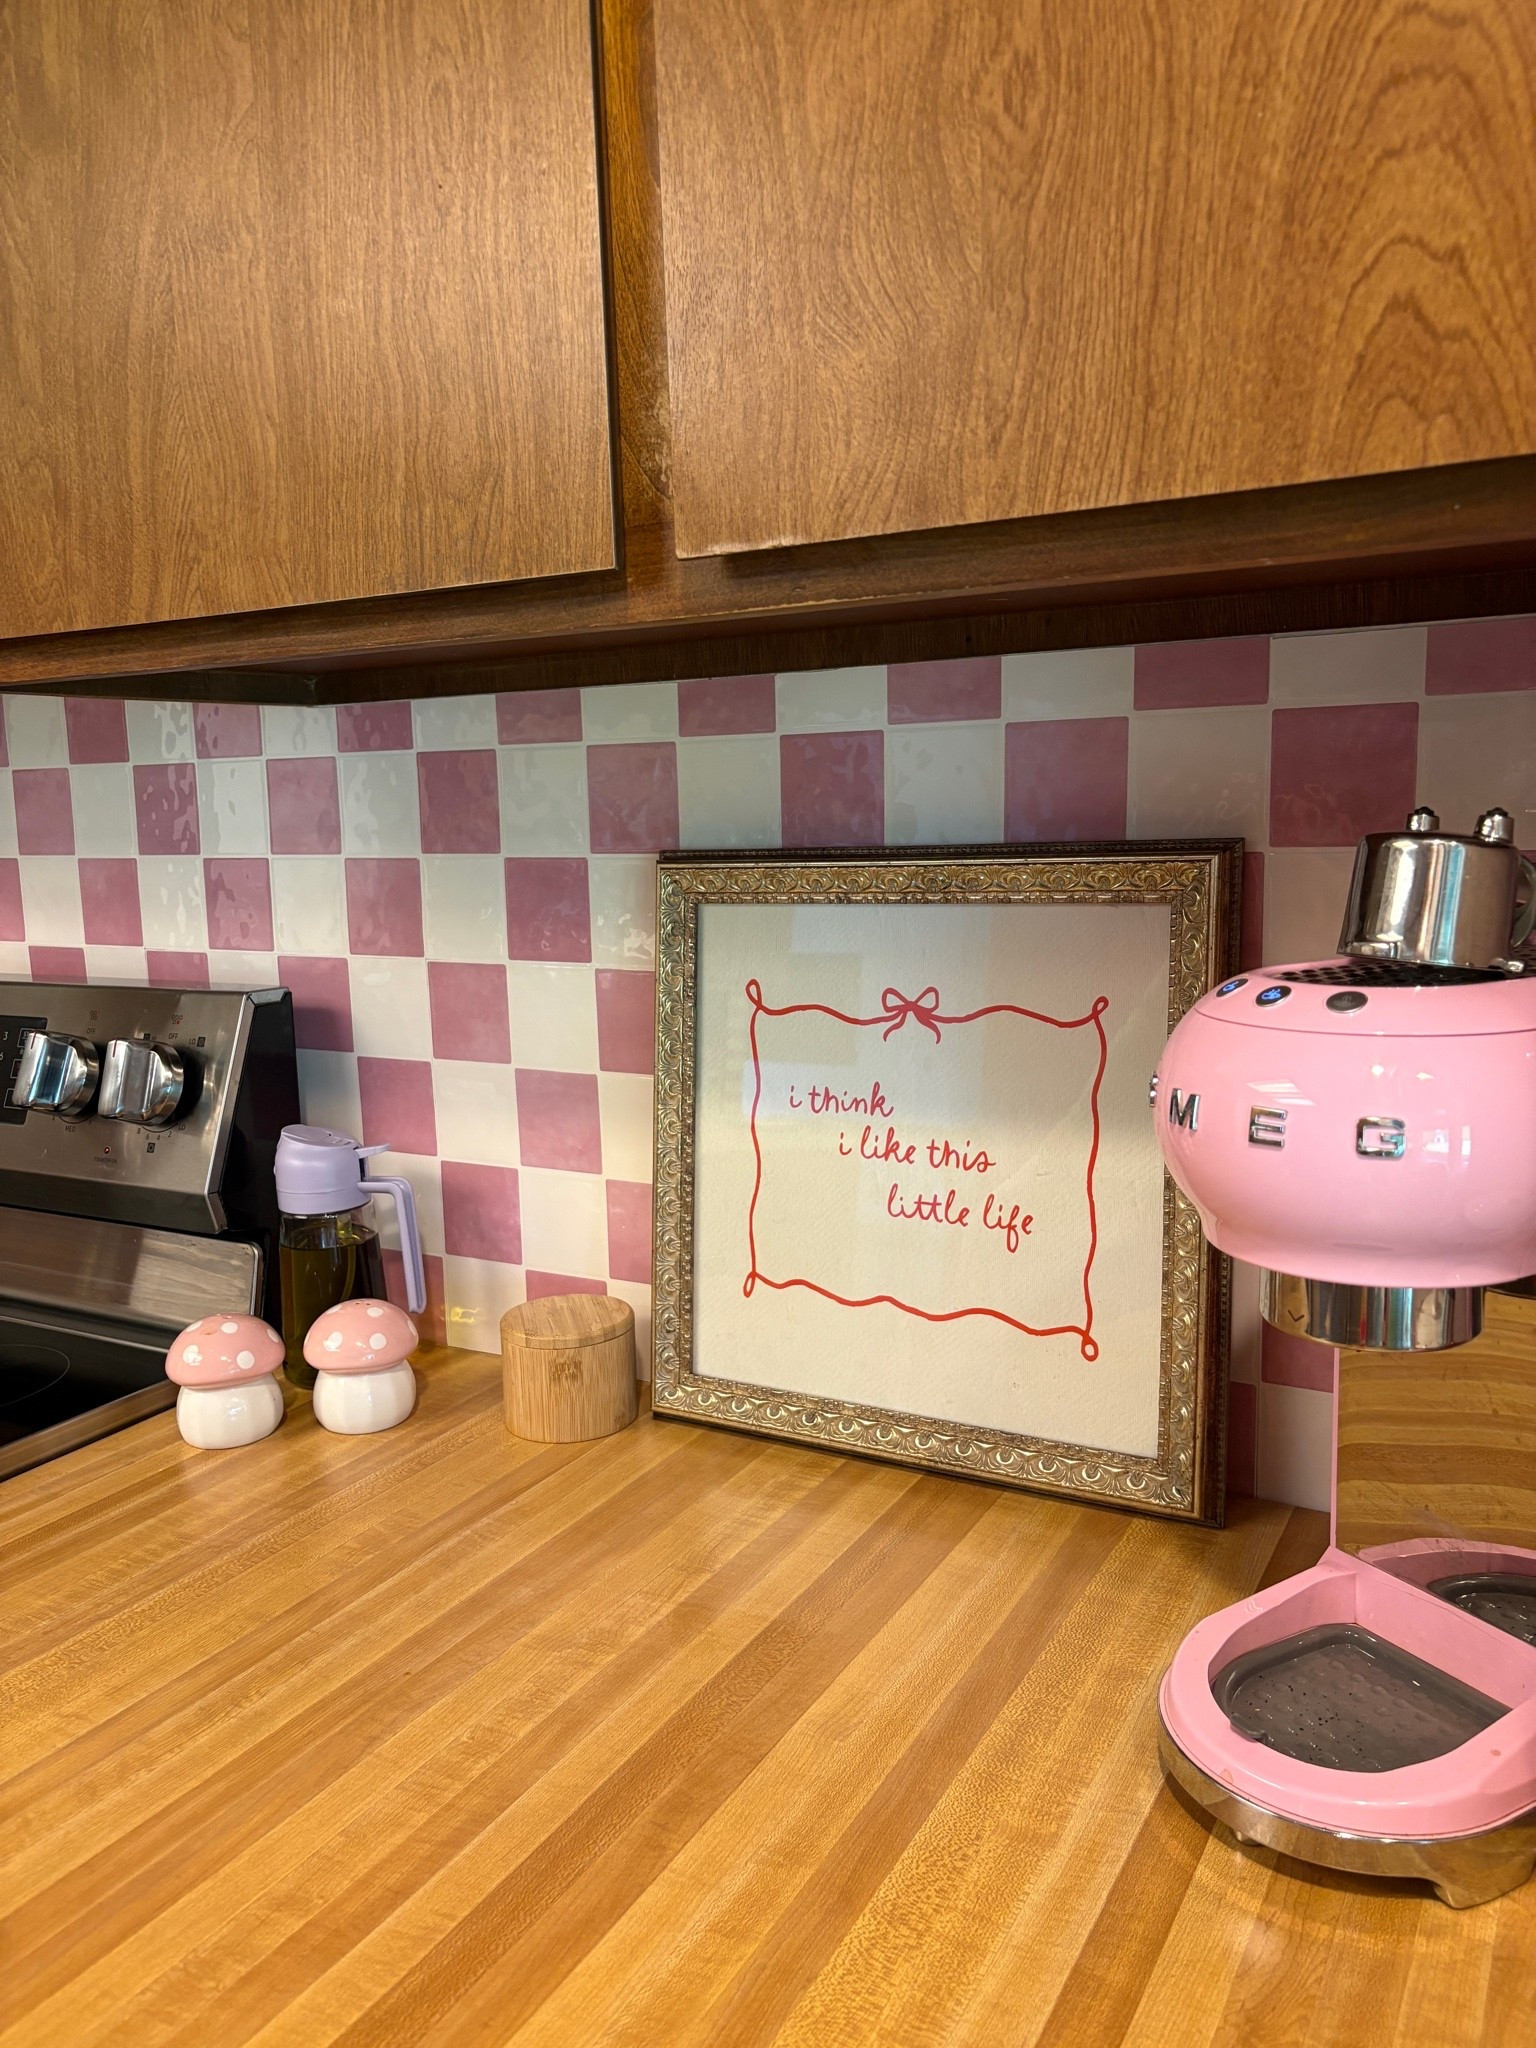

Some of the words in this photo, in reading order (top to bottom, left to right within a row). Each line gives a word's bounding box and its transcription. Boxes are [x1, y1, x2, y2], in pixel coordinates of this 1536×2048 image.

[3, 1031, 9, 1041] 3
[168, 1032, 179, 1040] OFF
[790, 1085, 802, 1108] i
[808, 1081, 894, 1117] think
[839, 1132, 852, 1155] i
[861, 1125, 916, 1164] like
[926, 1139, 996, 1173] this
[887, 1183, 969, 1227] little
[983, 1194, 1033, 1253] life
